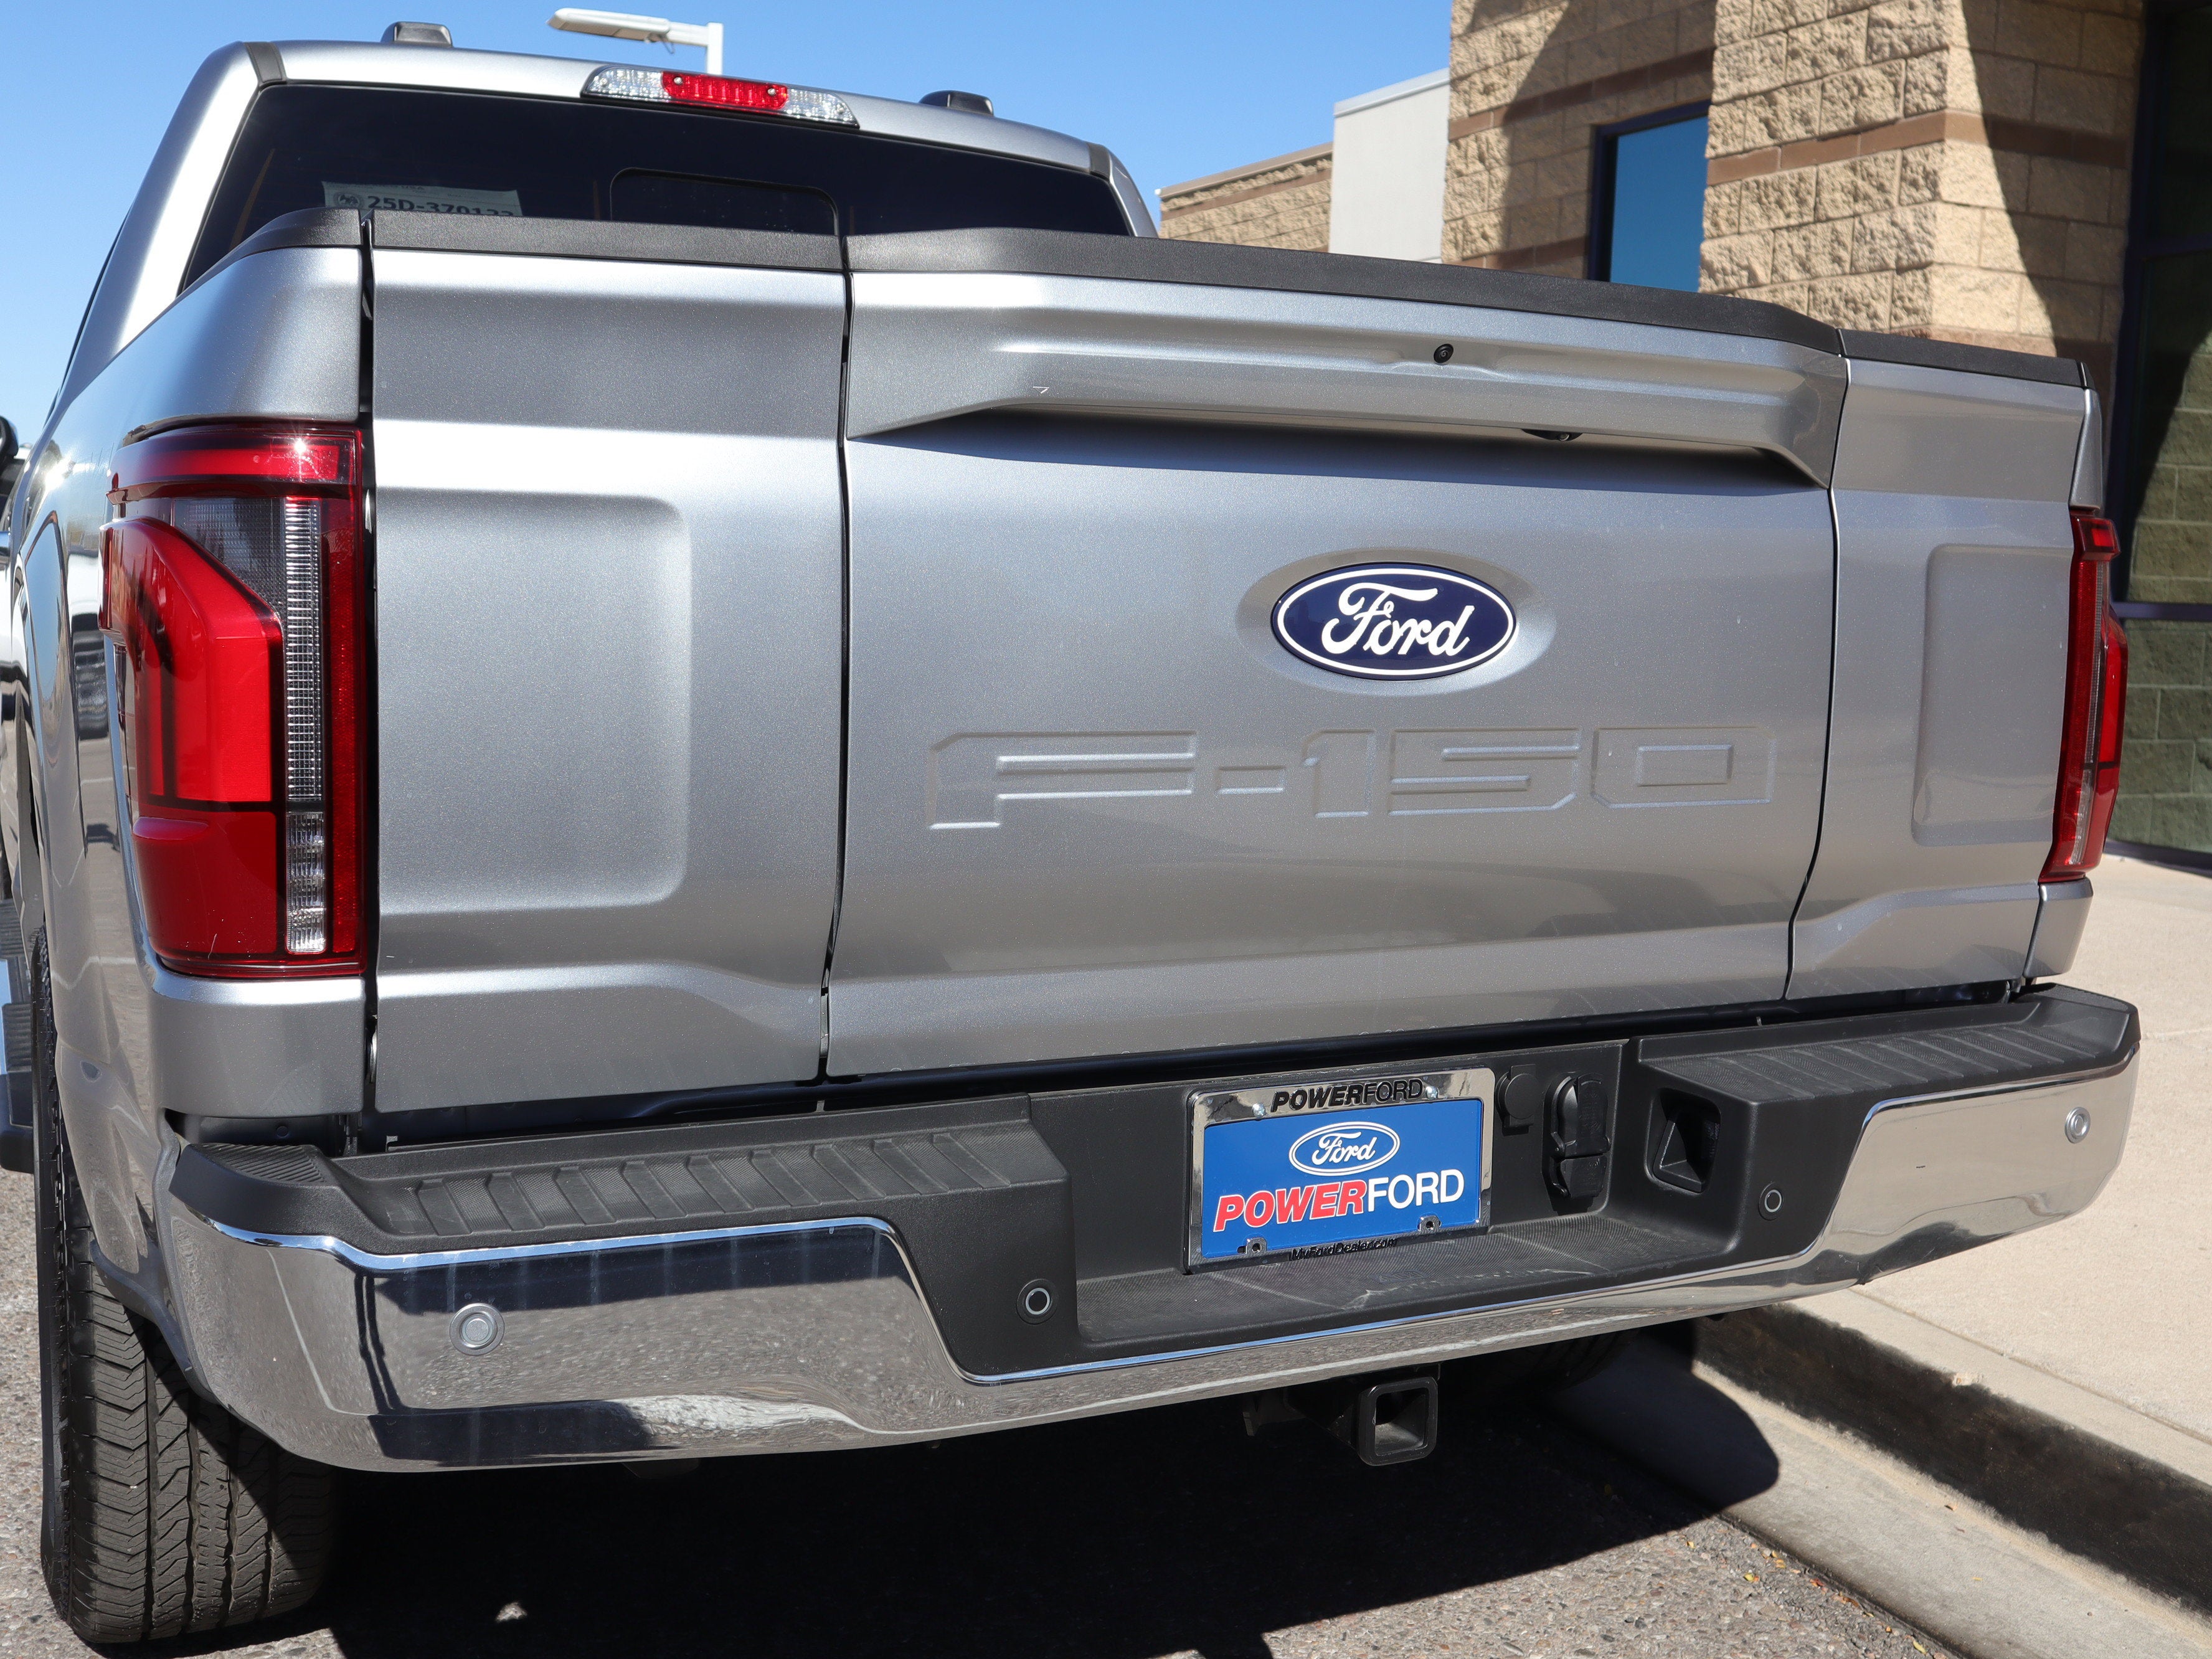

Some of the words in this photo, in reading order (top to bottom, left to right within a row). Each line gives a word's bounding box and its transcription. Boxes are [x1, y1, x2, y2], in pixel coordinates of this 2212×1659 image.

[1321, 582, 1475, 656] Ford
[929, 726, 1776, 830] F-150
[1270, 1078, 1424, 1113] POWERFORD
[1312, 1132, 1378, 1165] Ford
[1213, 1169, 1465, 1232] POWERFORD
